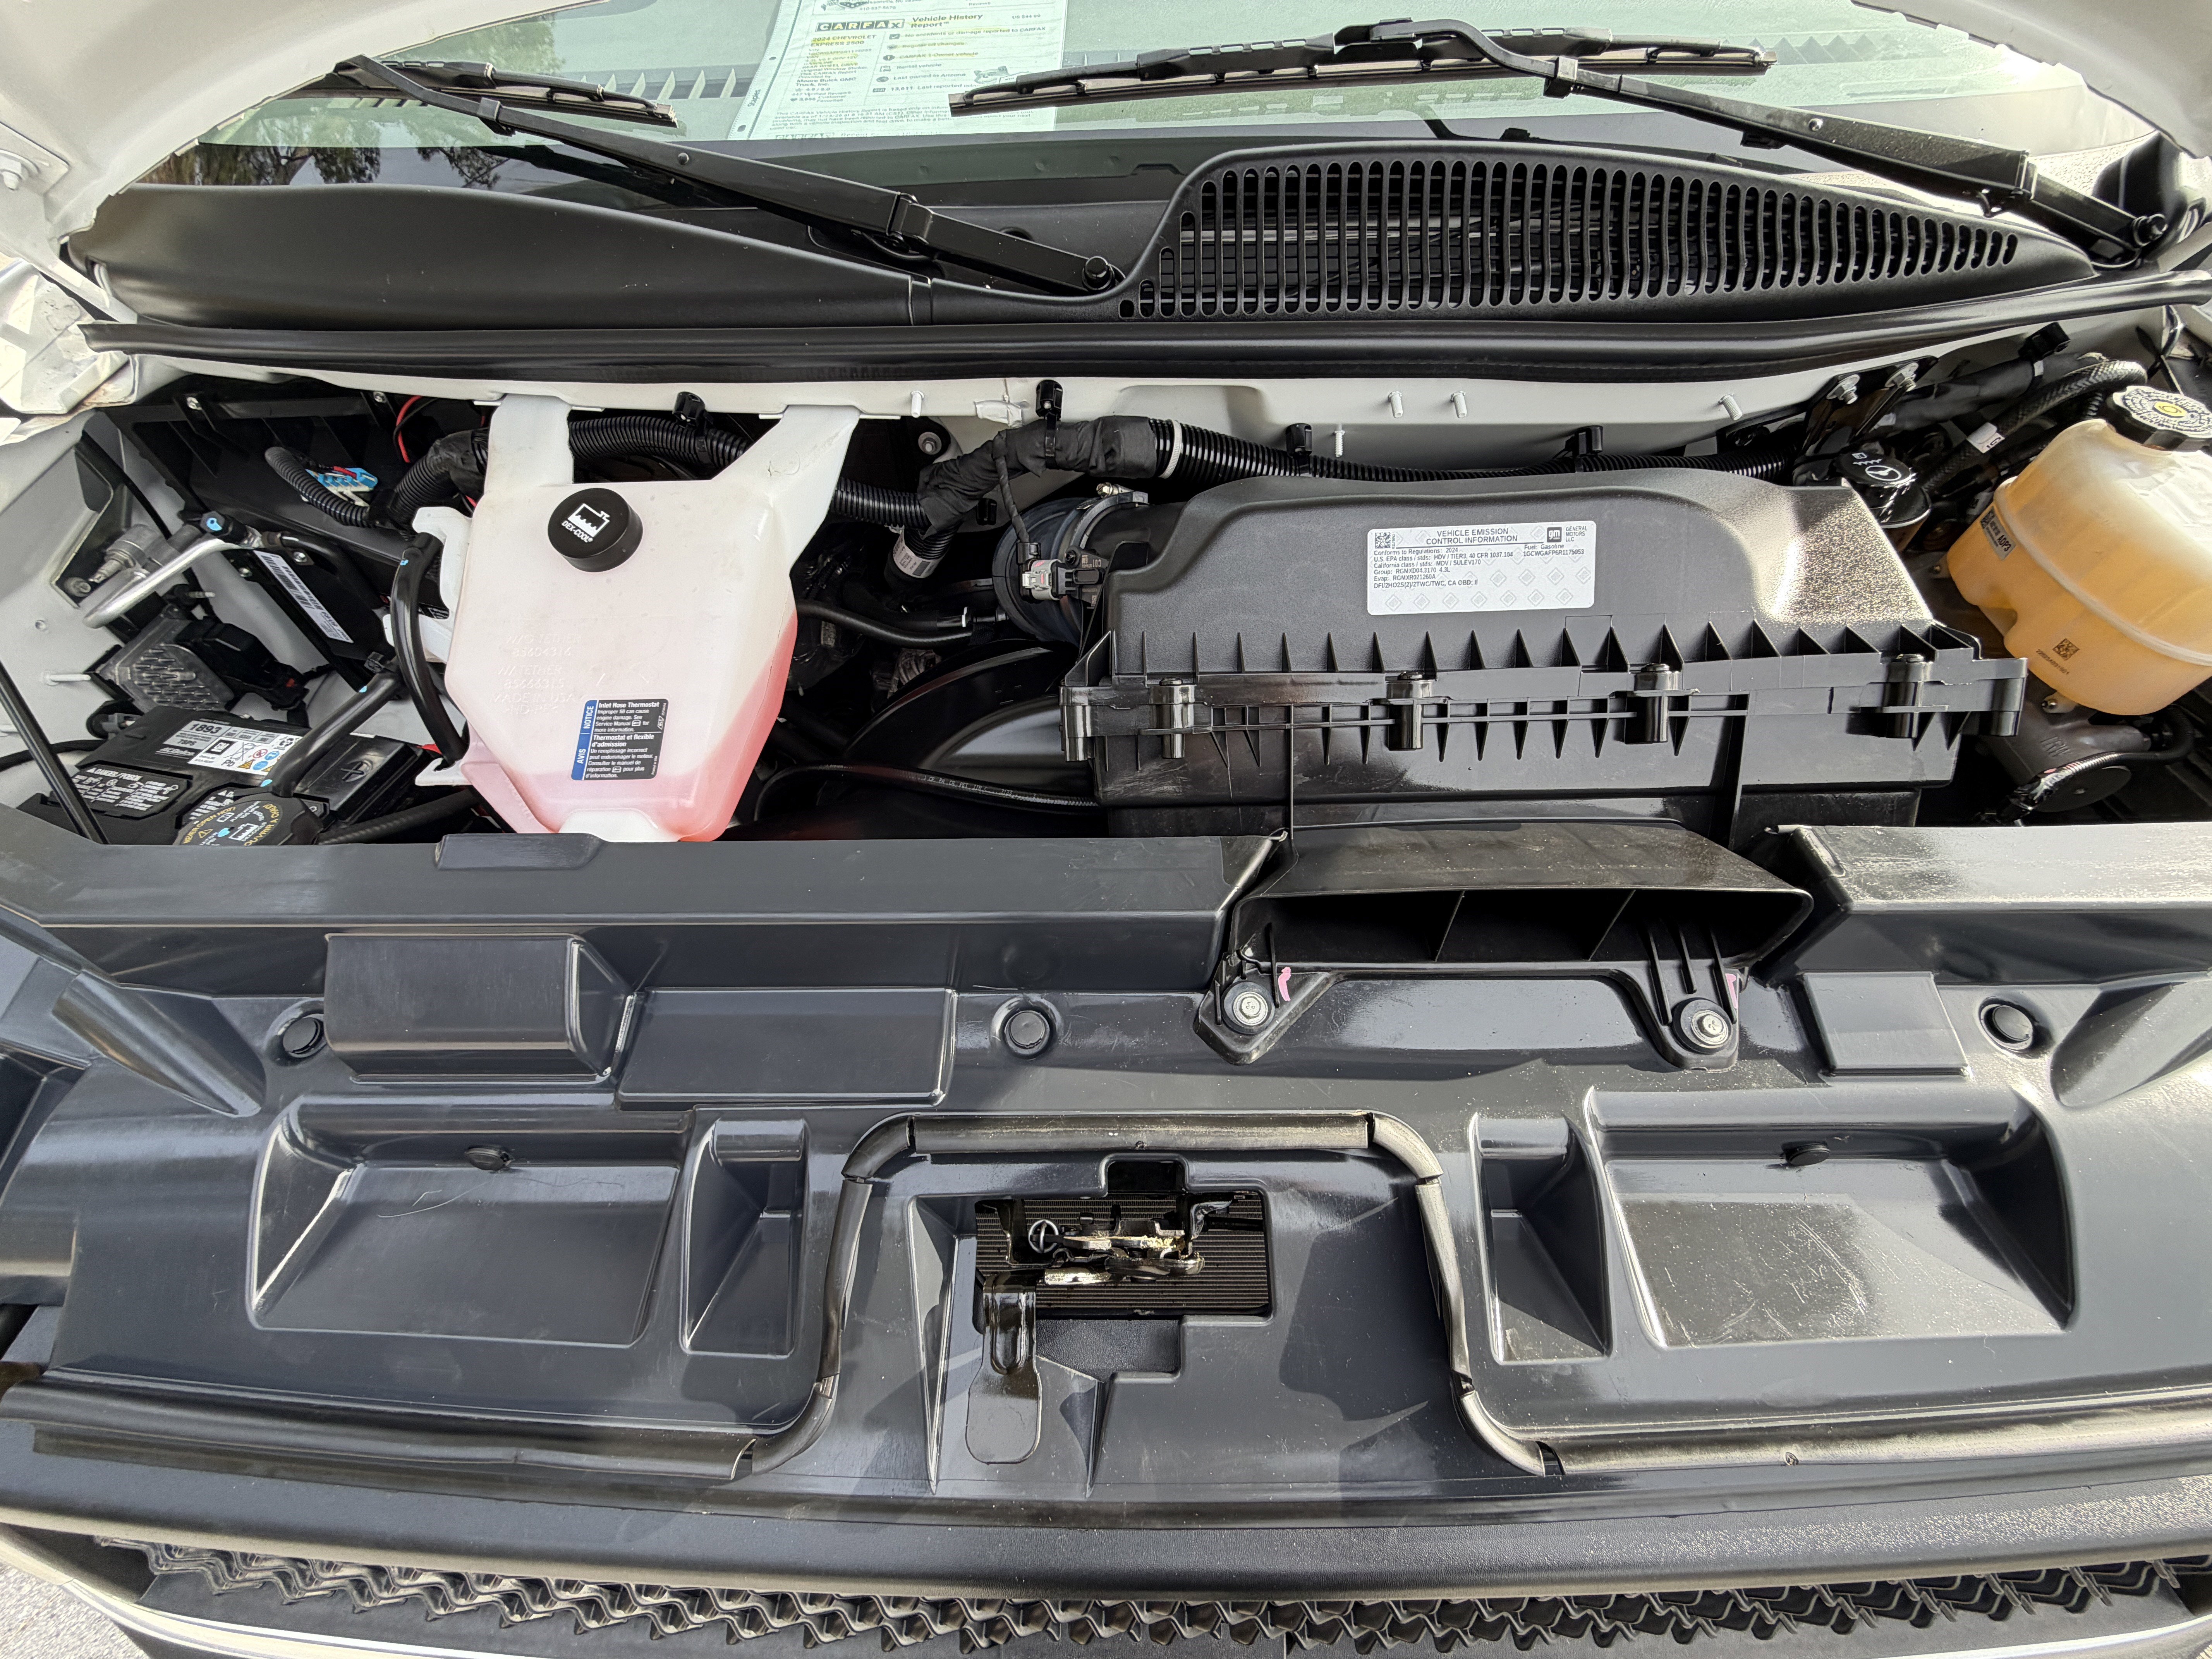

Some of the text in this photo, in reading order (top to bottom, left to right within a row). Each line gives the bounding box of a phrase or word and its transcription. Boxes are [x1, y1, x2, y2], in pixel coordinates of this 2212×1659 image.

[817, 19, 903, 31] CARFAX
[1465, 535, 1518, 543] INFORMATION
[1548, 530, 1560, 540] gm
[583, 706, 594, 729] NOTICE
[188, 723, 222, 734] 1893
[577, 748, 587, 764] AVIS
[221, 759, 236, 767] Pb
[183, 827, 198, 844] NEVER
[196, 814, 217, 828] OPEN
[244, 824, 275, 847] OUVRIR
